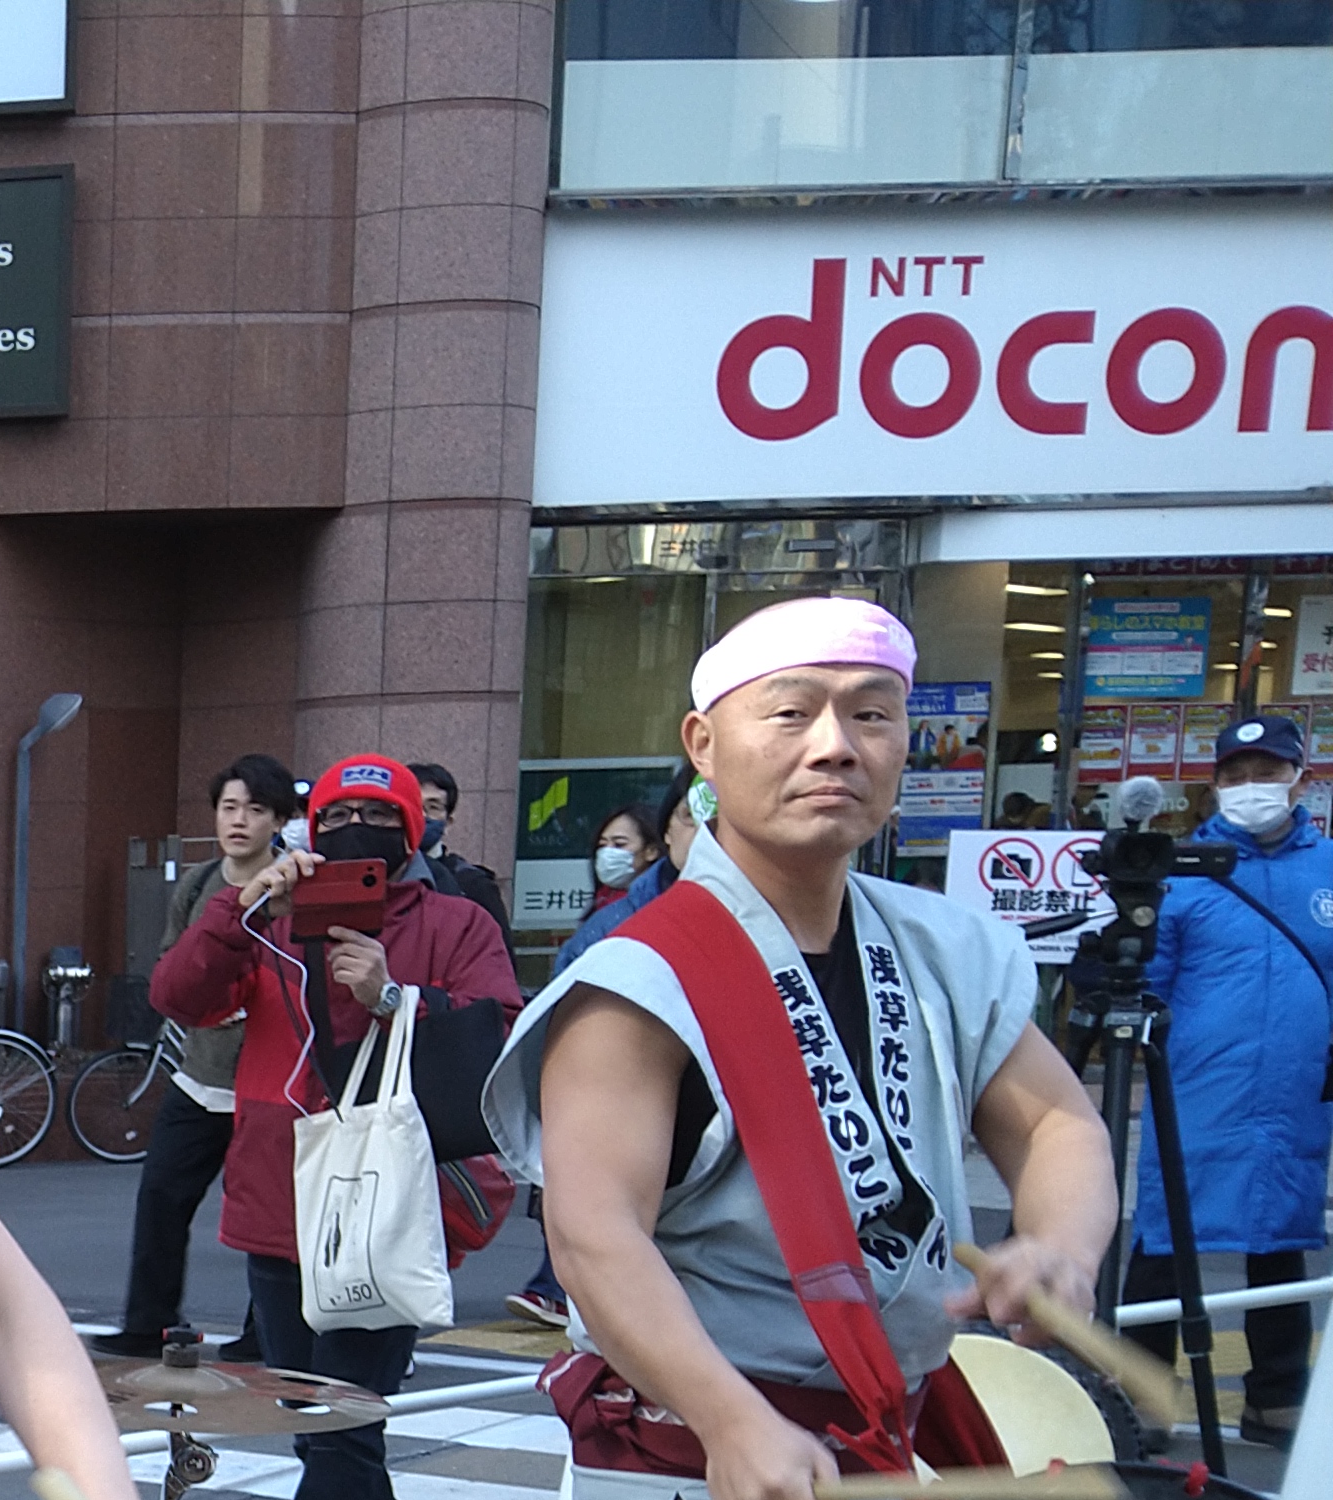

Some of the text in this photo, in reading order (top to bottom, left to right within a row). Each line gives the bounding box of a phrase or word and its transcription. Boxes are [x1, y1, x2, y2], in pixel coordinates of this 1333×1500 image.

[870, 254, 985, 297] NTT
[991, 888, 1097, 913] 撮影禁止
